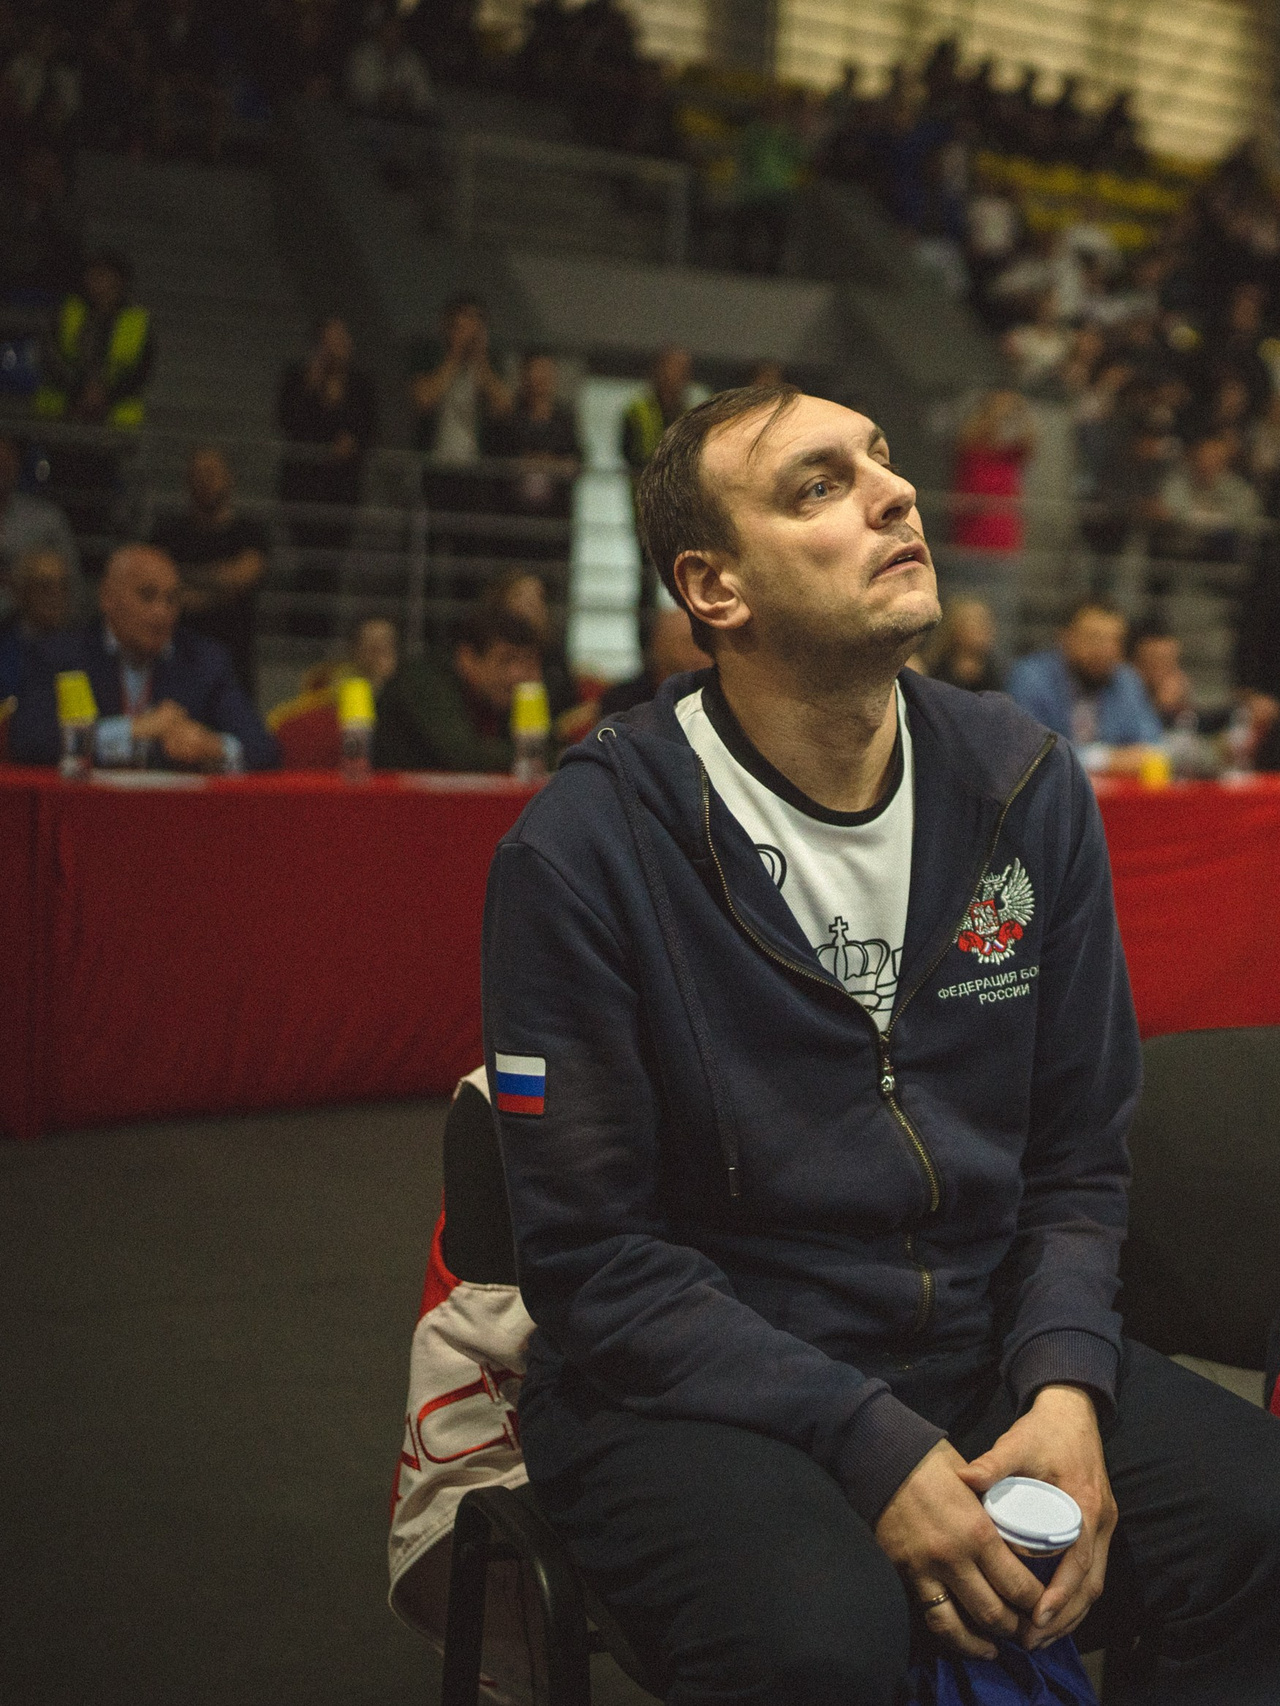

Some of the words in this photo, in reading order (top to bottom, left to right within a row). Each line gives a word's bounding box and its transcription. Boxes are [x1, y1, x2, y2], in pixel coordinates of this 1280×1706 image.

[937, 970, 1018, 1000] ФЕДЕРАЦИЯ
[1020, 965, 1040, 980] БО
[978, 982, 1031, 1005] РОССИИ
